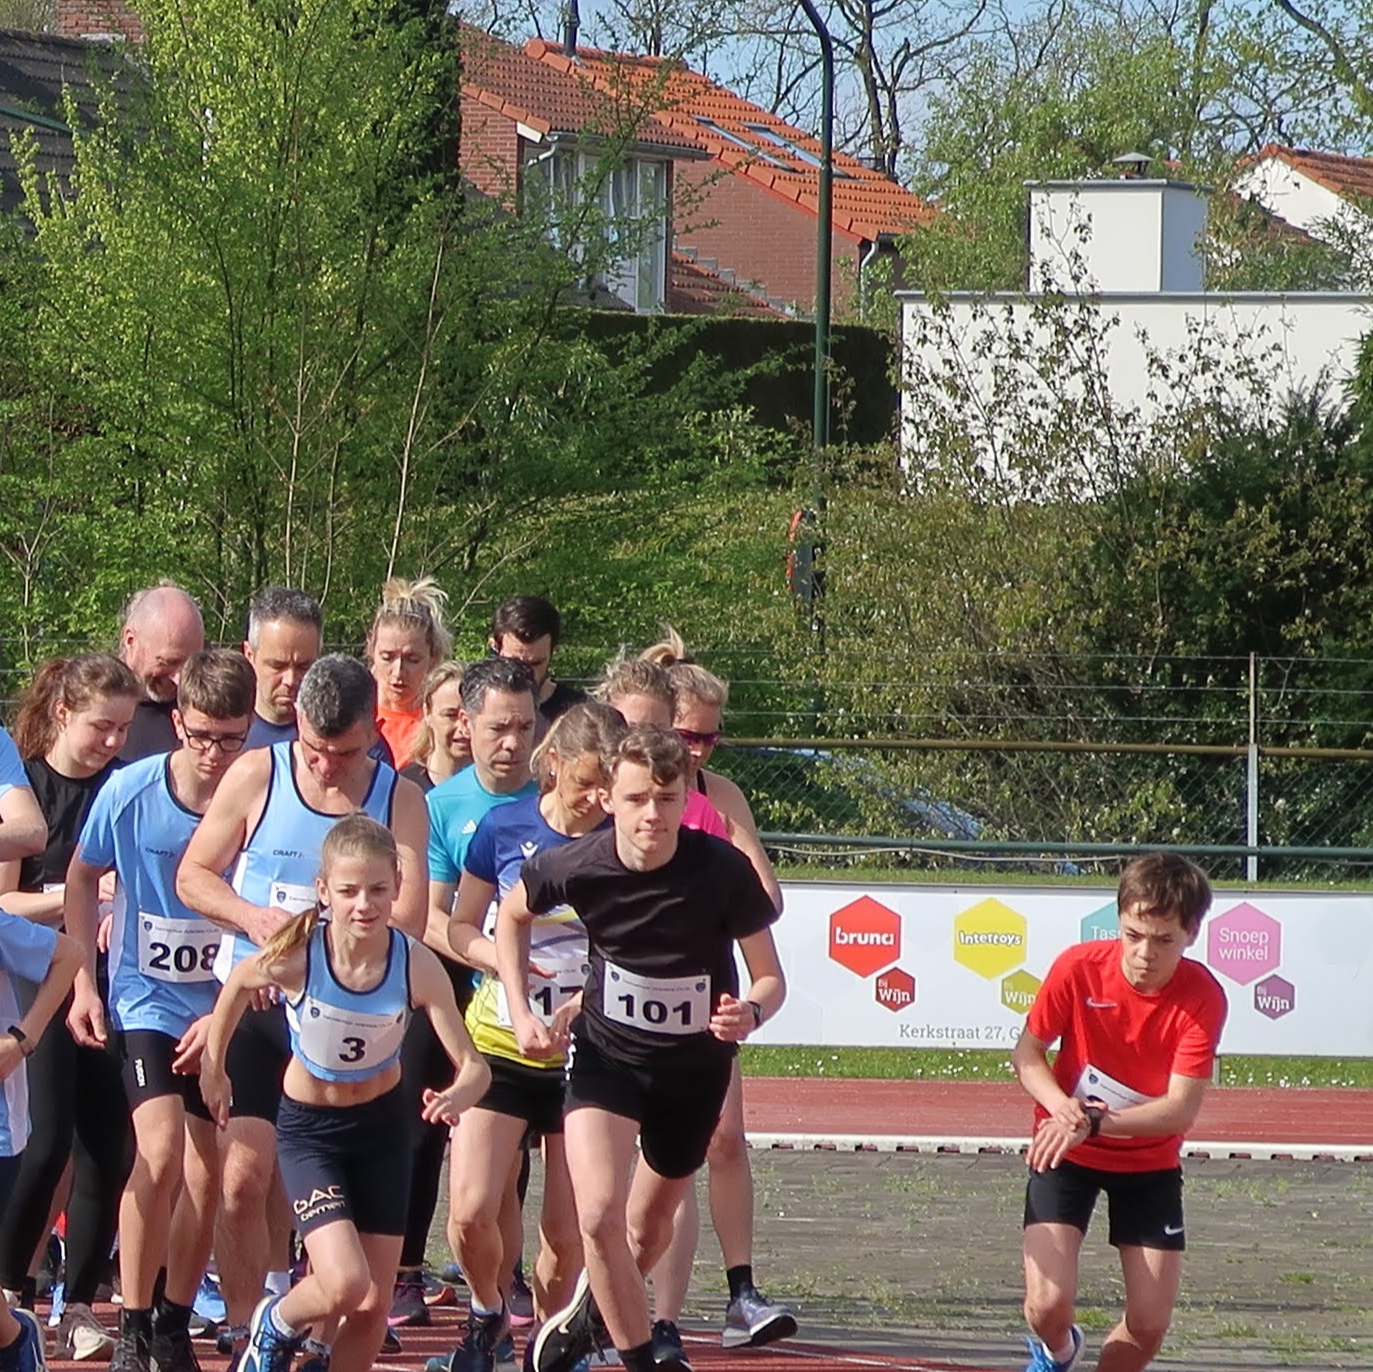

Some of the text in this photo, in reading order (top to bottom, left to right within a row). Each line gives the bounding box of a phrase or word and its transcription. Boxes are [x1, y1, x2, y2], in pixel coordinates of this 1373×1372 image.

[835, 926, 894, 946] bruna
[958, 930, 1023, 947] Intertoys
[1218, 928, 1270, 946] Snoep
[149, 942, 221, 973] 208
[1218, 945, 1269, 961] winkel
[878, 988, 911, 1004] Wijn
[1257, 996, 1290, 1013] Wijn
[618, 993, 692, 1026] 101
[899, 1024, 981, 1040] Kerkstraat
[984, 1026, 1006, 1041] 27,
[338, 1036, 366, 1063] 3
[293, 1185, 345, 1215] GAC
